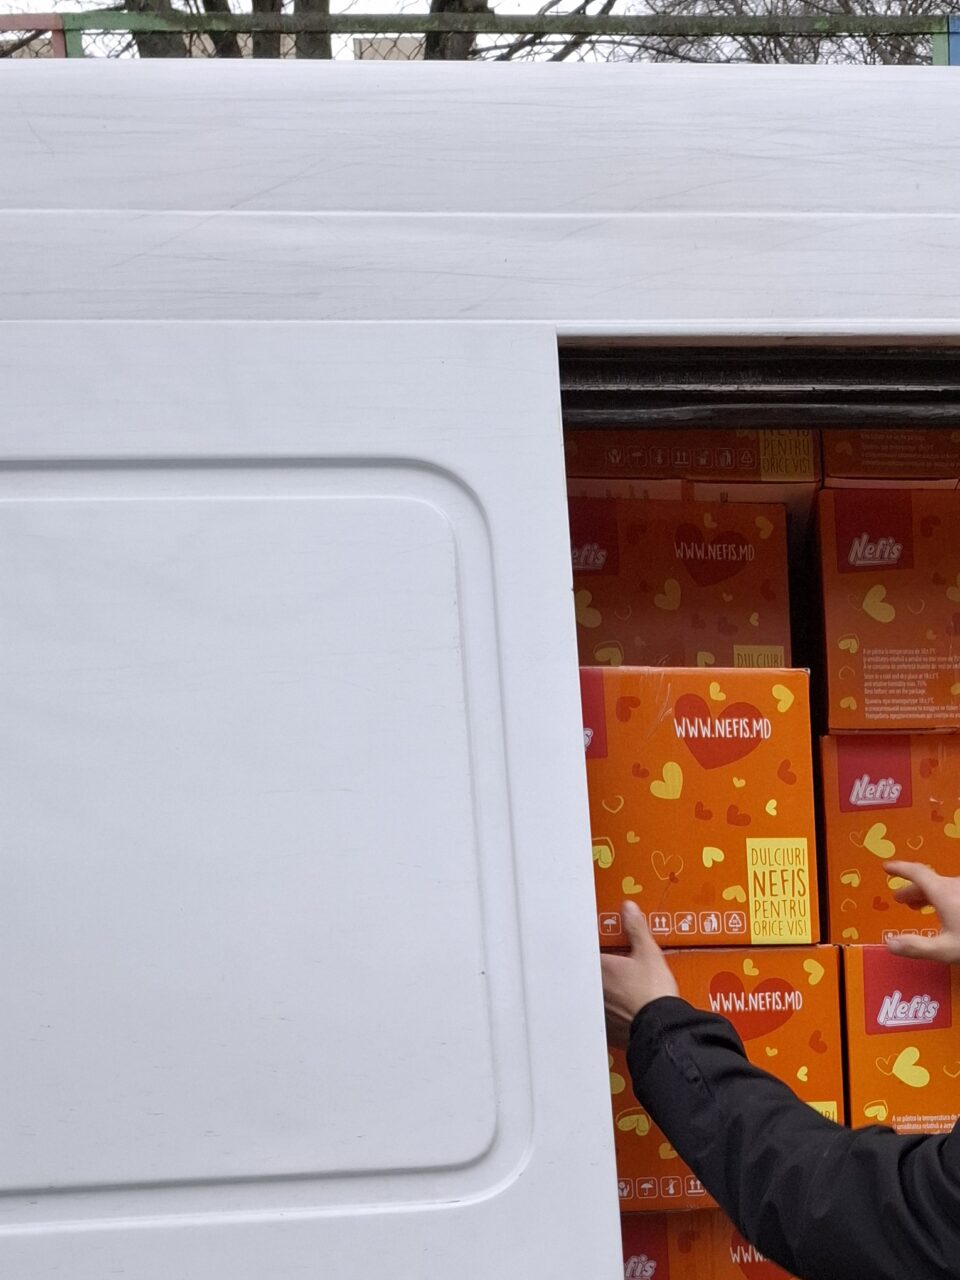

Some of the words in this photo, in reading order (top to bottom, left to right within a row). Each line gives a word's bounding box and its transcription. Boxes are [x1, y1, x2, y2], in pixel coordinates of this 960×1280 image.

[764, 439, 810, 457] PENTRU
[571, 542, 607, 570] efis
[673, 541, 756, 562] WWW.NEFIS.MD
[848, 533, 904, 566] Nefis
[673, 717, 772, 740] WWW.NEFIS.MD
[849, 773, 903, 806] Nefis
[751, 847, 806, 867] DULCIURI
[753, 868, 807, 898] NEFIS
[754, 899, 807, 919] PENTRU
[753, 918, 784, 937] ORICE
[786, 918, 808, 937] VIS!
[708, 991, 803, 1013] WWW.NEFIS.MD
[876, 989, 940, 1027] Nefis
